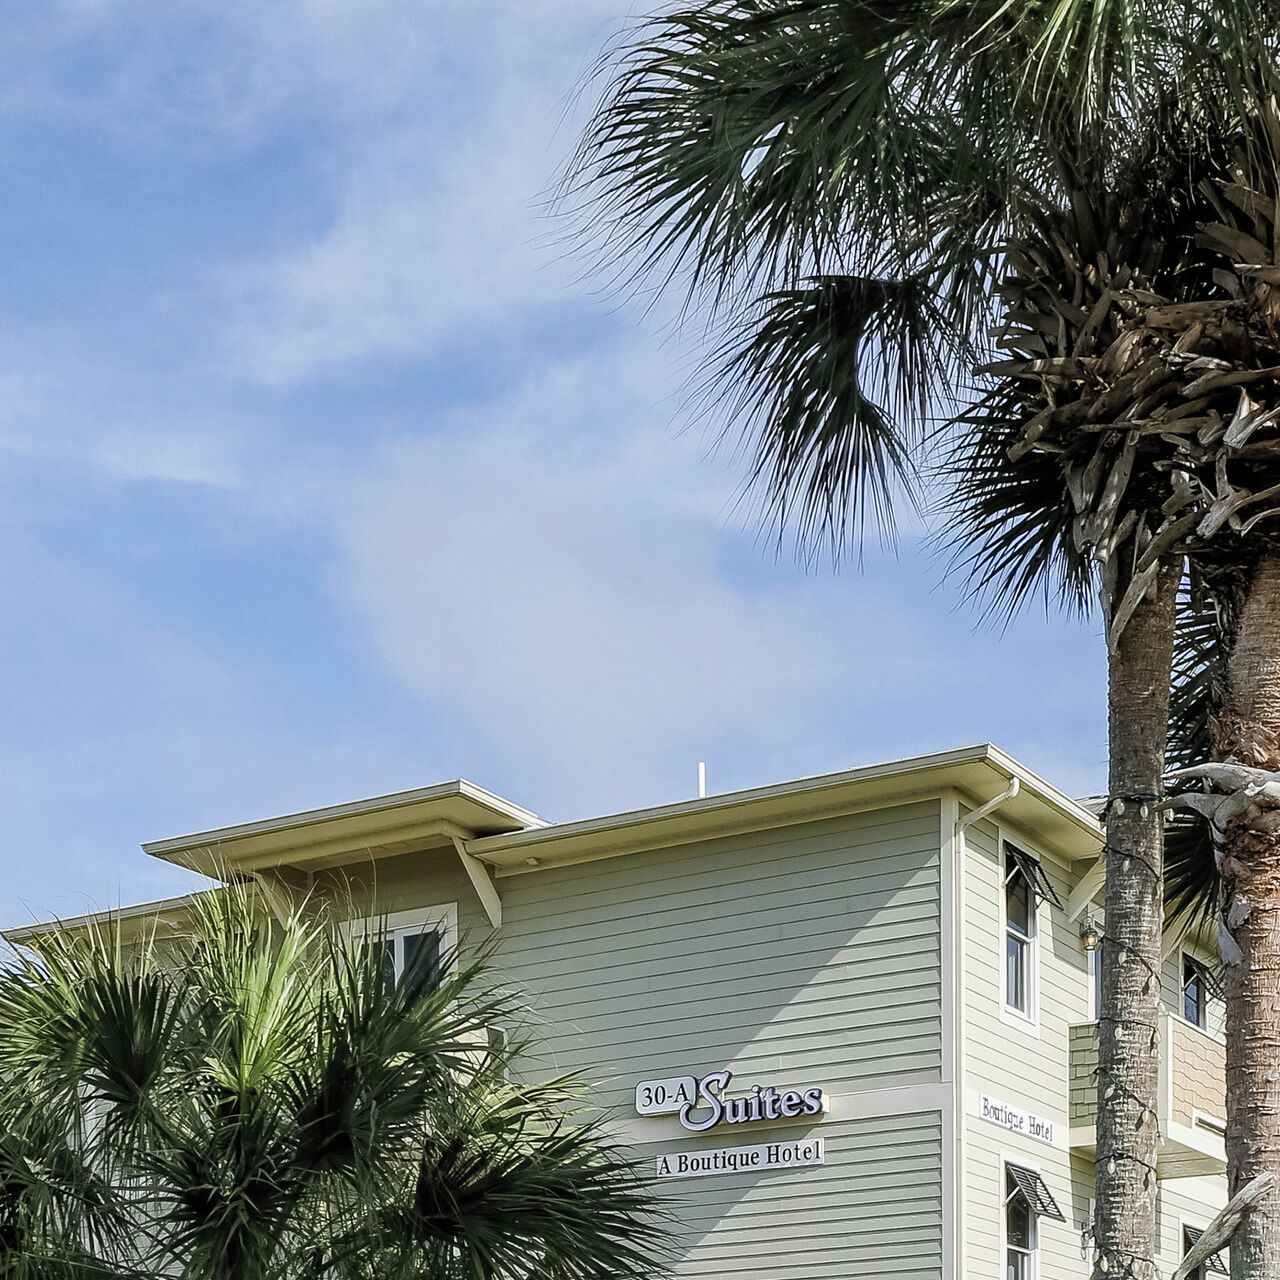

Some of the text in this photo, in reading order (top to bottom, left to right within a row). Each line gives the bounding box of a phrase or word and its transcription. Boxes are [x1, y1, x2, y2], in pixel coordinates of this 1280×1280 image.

[642, 1070, 823, 1131] 30-A Suites
[1029, 1115, 1053, 1142] Hotel
[658, 1141, 821, 1175] A Boutique Hotel
